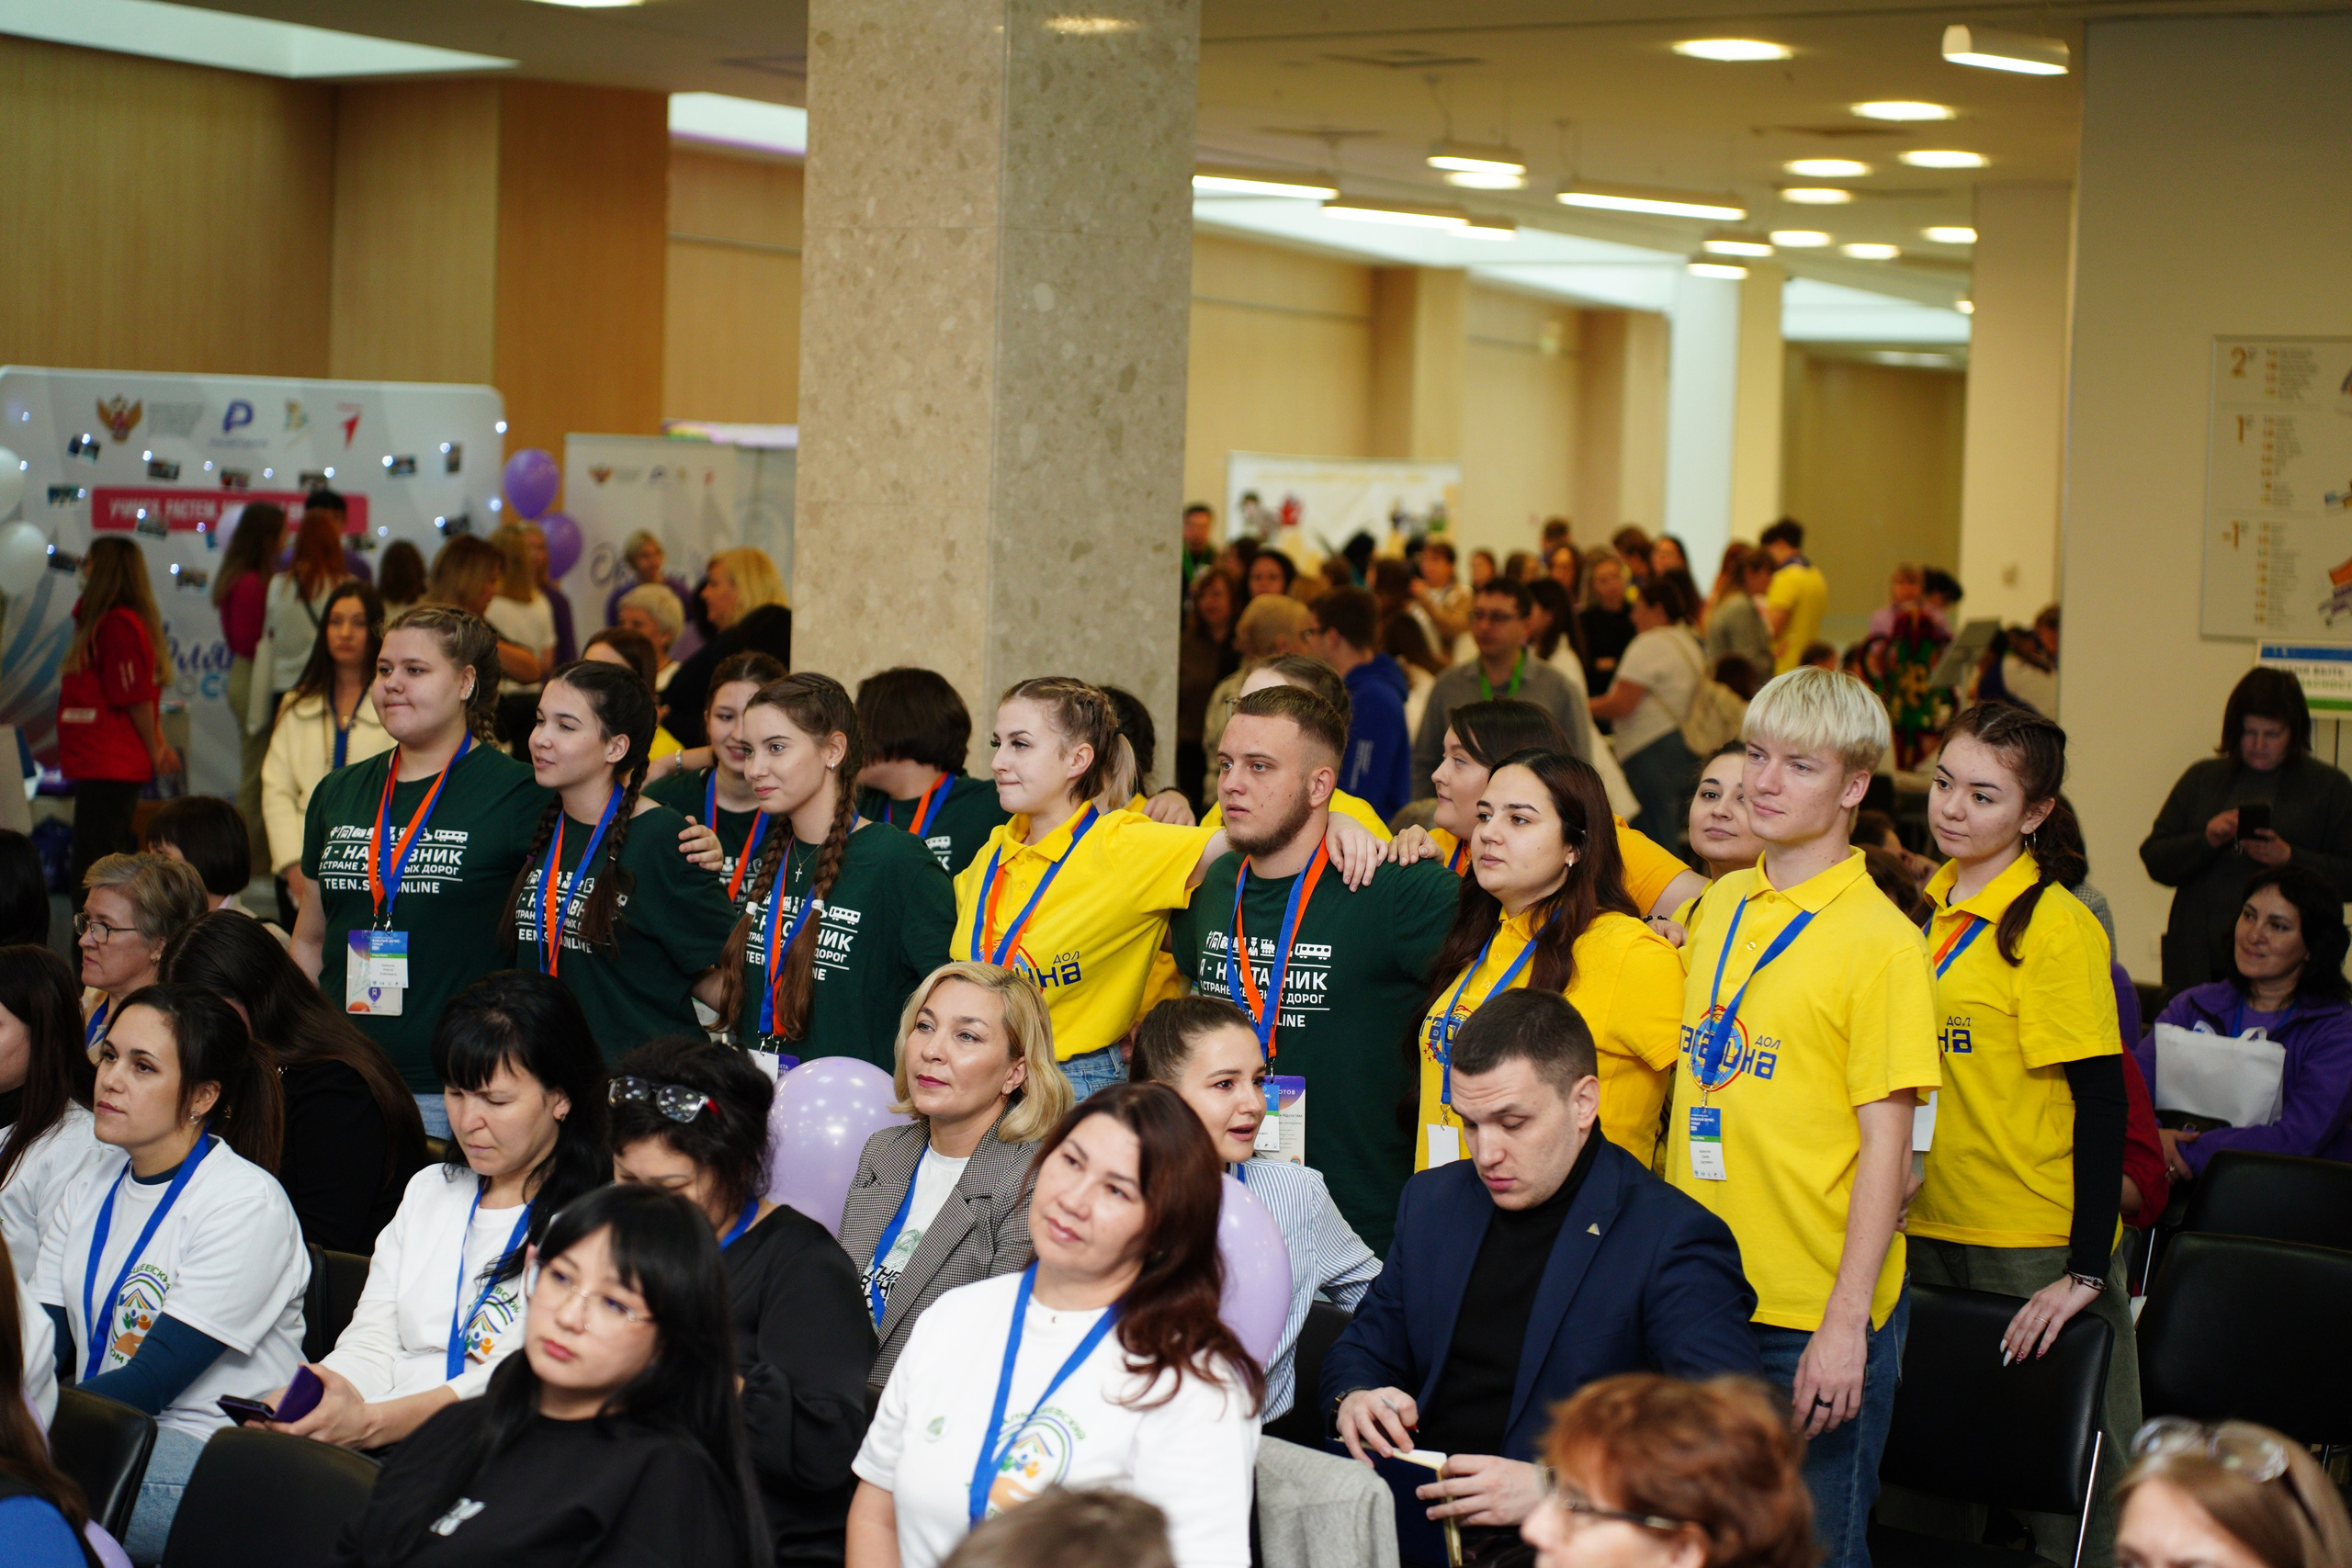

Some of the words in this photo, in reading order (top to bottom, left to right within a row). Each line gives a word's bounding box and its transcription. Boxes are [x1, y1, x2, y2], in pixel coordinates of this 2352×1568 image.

[322, 861, 358, 871] СТРАНЕ
[421, 863, 459, 875] ДОРОГ
[1052, 951, 1080, 965] ДОЛ
[1286, 992, 1325, 1005] ДОРОГ
[1946, 1015, 1971, 1027] ДОЛ
[1754, 1034, 1781, 1050] ДОЛ
